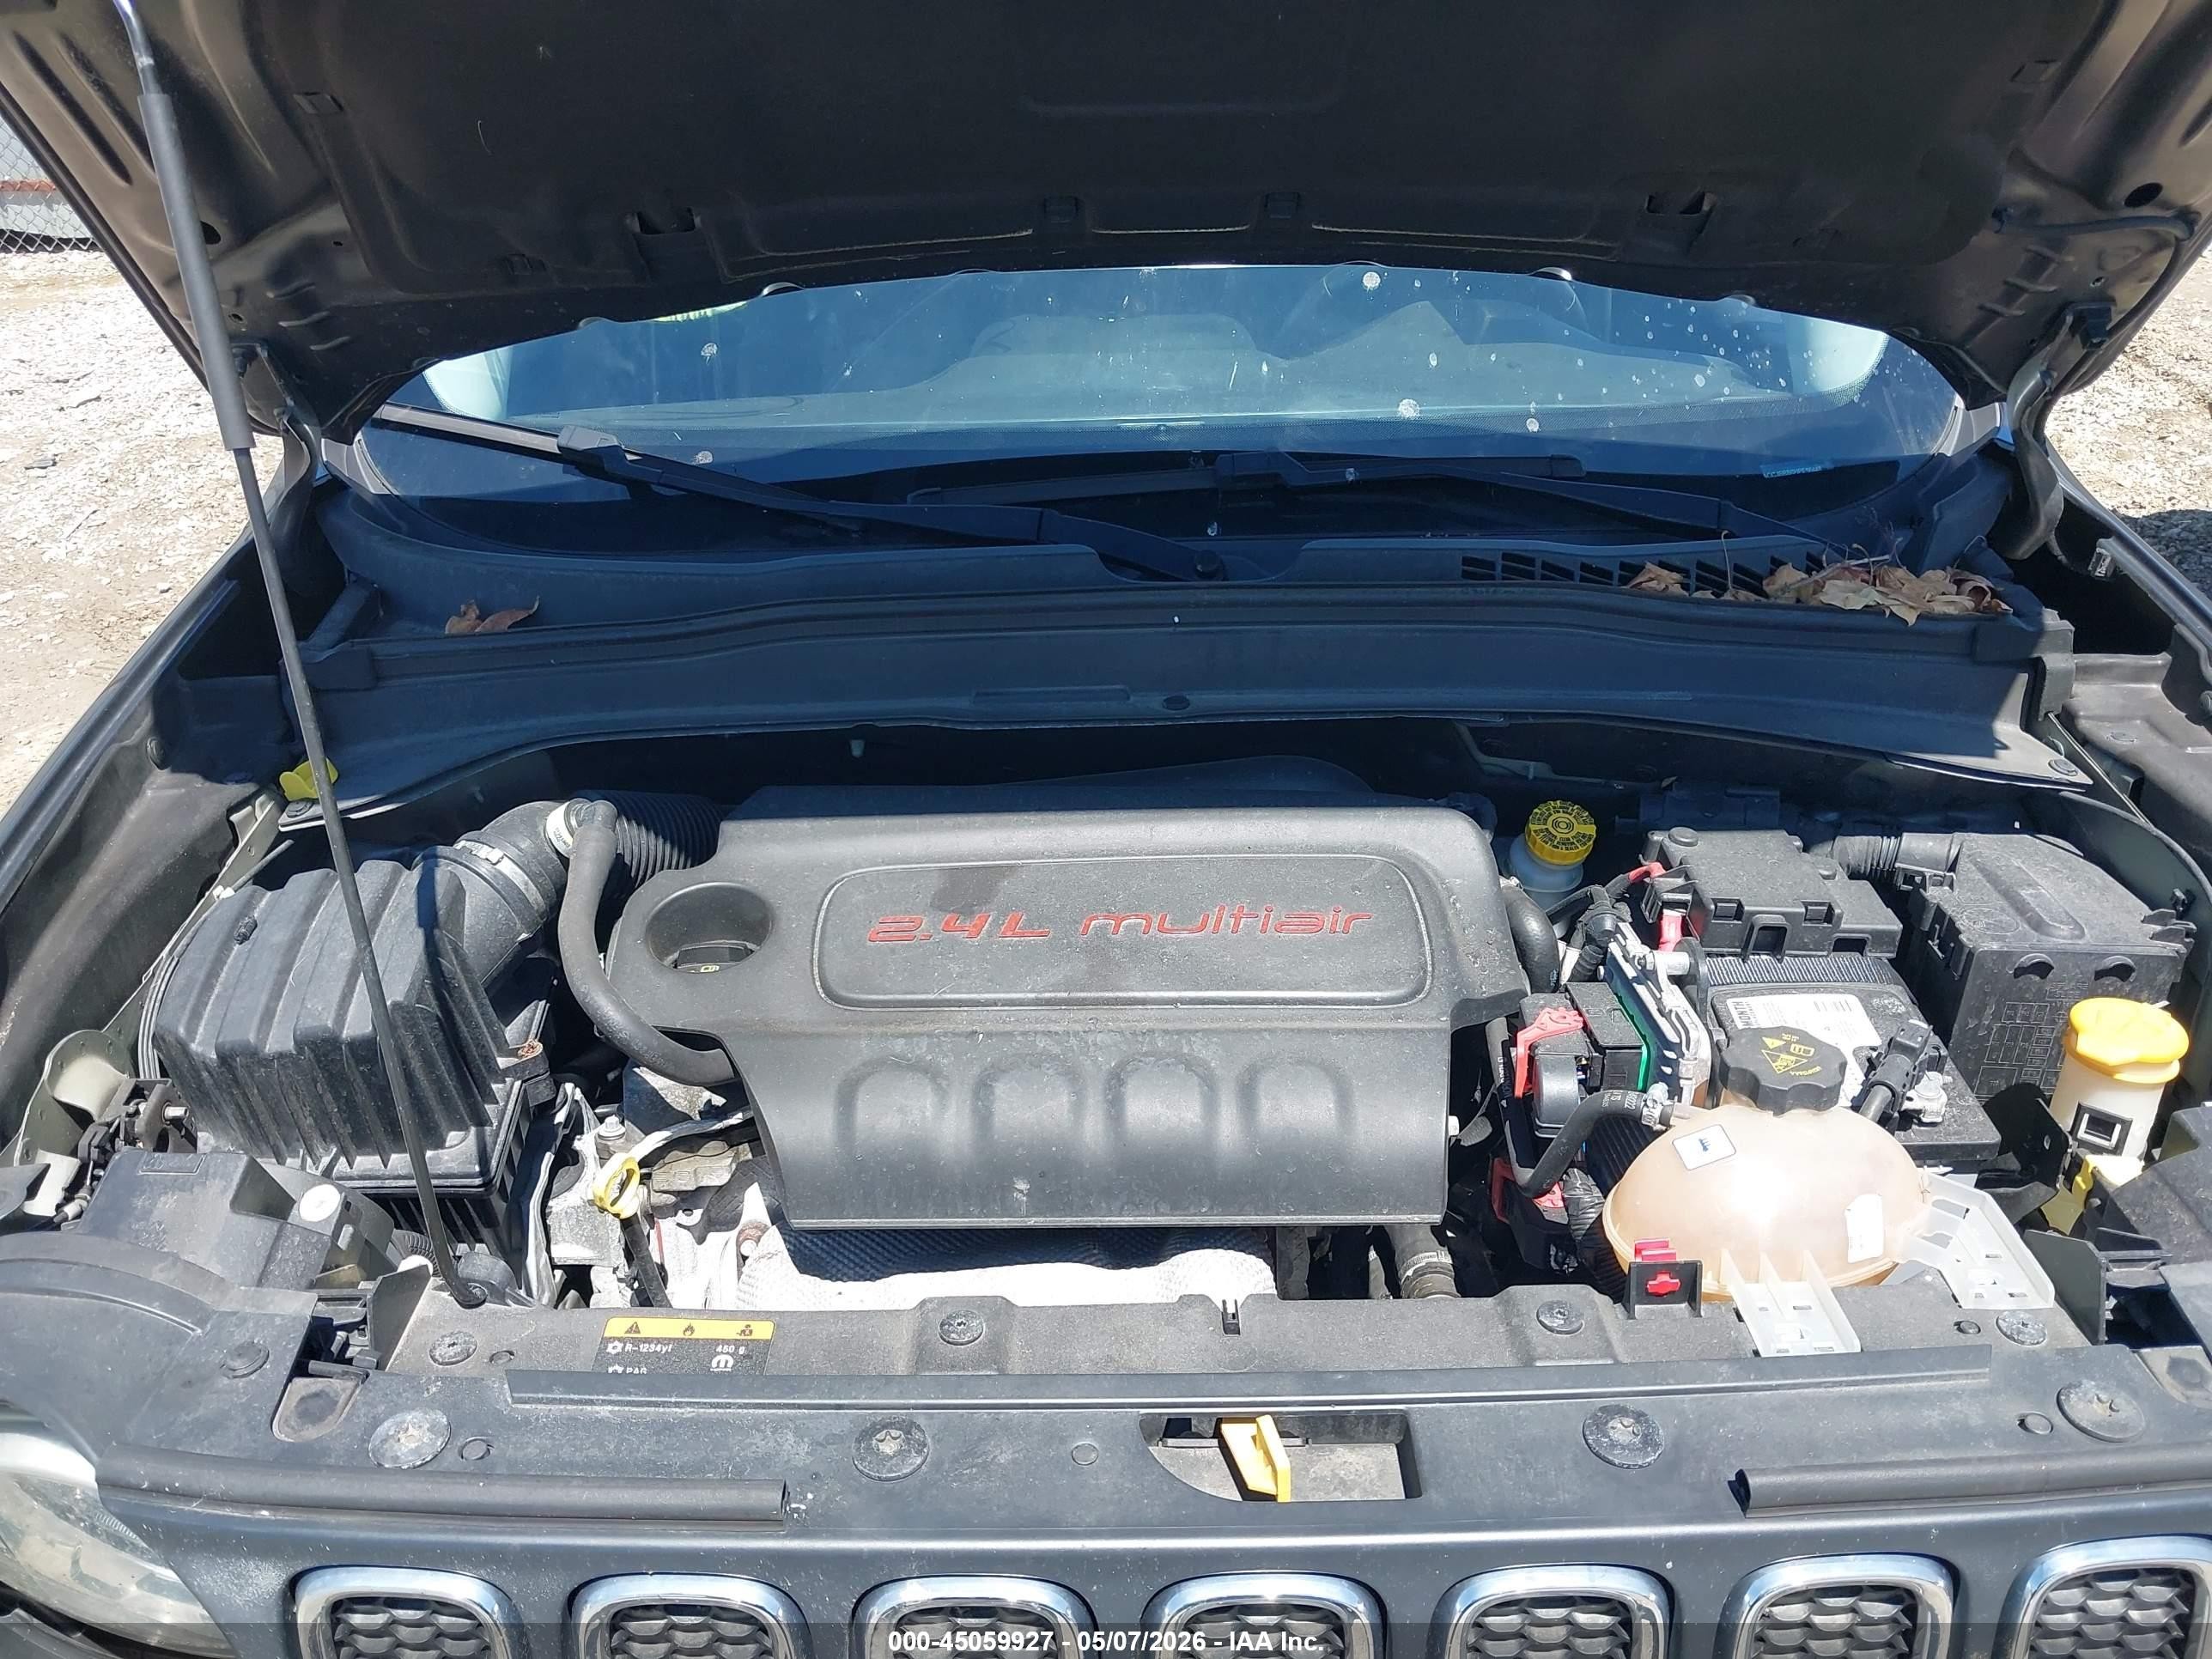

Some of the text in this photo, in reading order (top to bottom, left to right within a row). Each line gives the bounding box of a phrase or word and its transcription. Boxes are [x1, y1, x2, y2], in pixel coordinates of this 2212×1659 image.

[1079, 904, 1374, 937] multiair
[1731, 1001, 1754, 1026] MONTH
[624, 1343, 673, 1354] R-1234yf
[716, 1345, 735, 1354] 450
